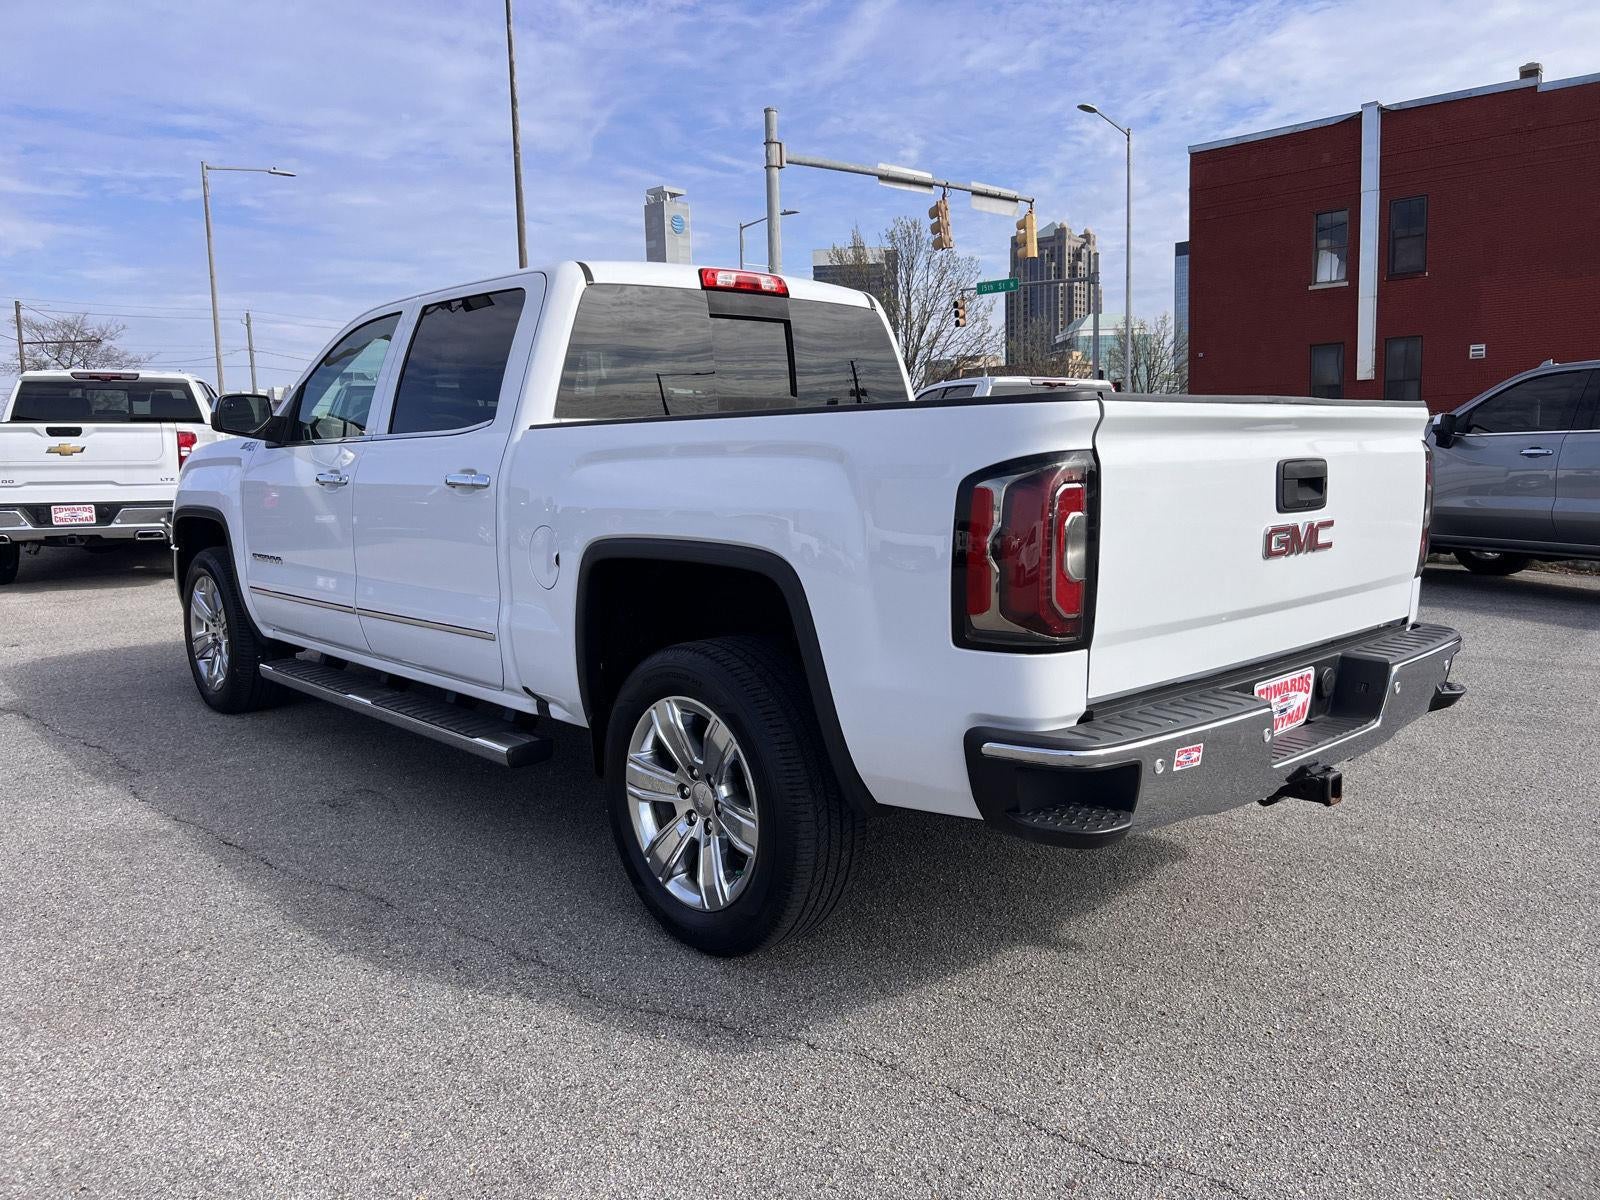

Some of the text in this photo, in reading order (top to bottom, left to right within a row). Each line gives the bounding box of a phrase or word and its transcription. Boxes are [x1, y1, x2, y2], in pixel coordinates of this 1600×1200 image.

[981, 284, 994, 292] 15th
[53, 506, 93, 515] EDWARDS
[54, 514, 94, 523] CHEVYMAN
[1262, 519, 1335, 560] GMC
[1274, 698, 1309, 731] VYMAN
